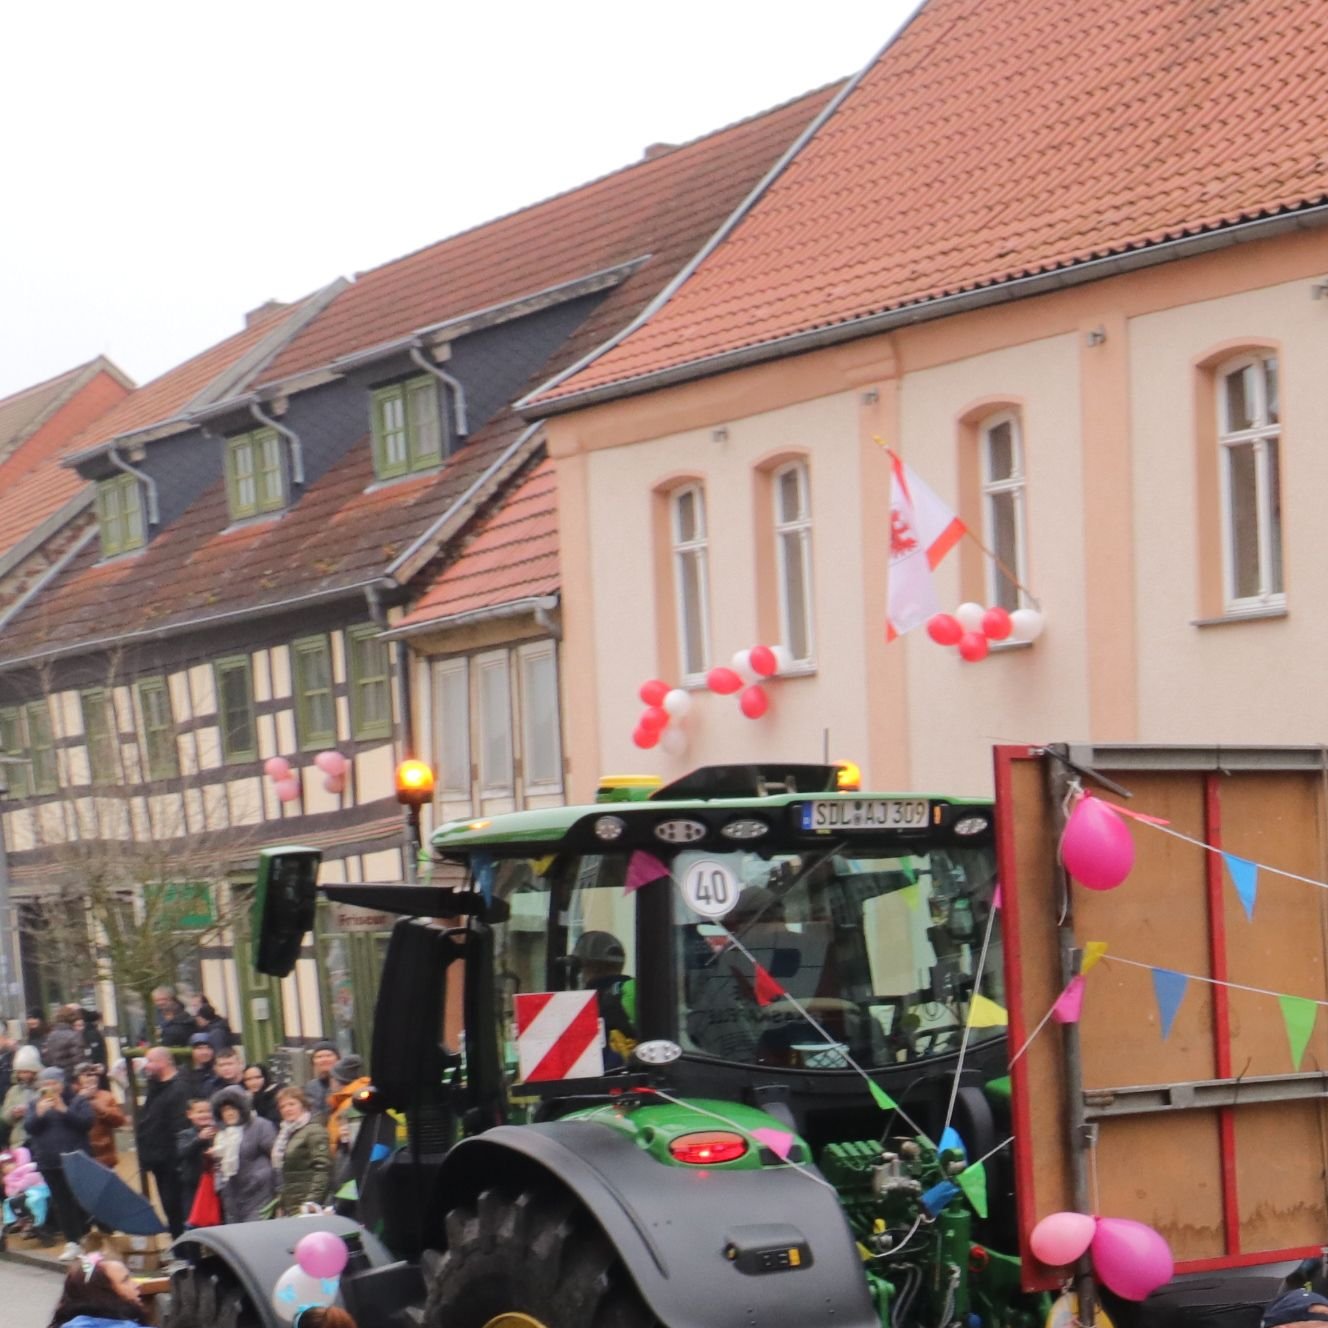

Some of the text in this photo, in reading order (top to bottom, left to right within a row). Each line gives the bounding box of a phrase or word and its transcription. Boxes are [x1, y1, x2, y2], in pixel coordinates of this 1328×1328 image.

[816, 802, 925, 825] SDL AJ 309
[695, 869, 729, 905] 40
